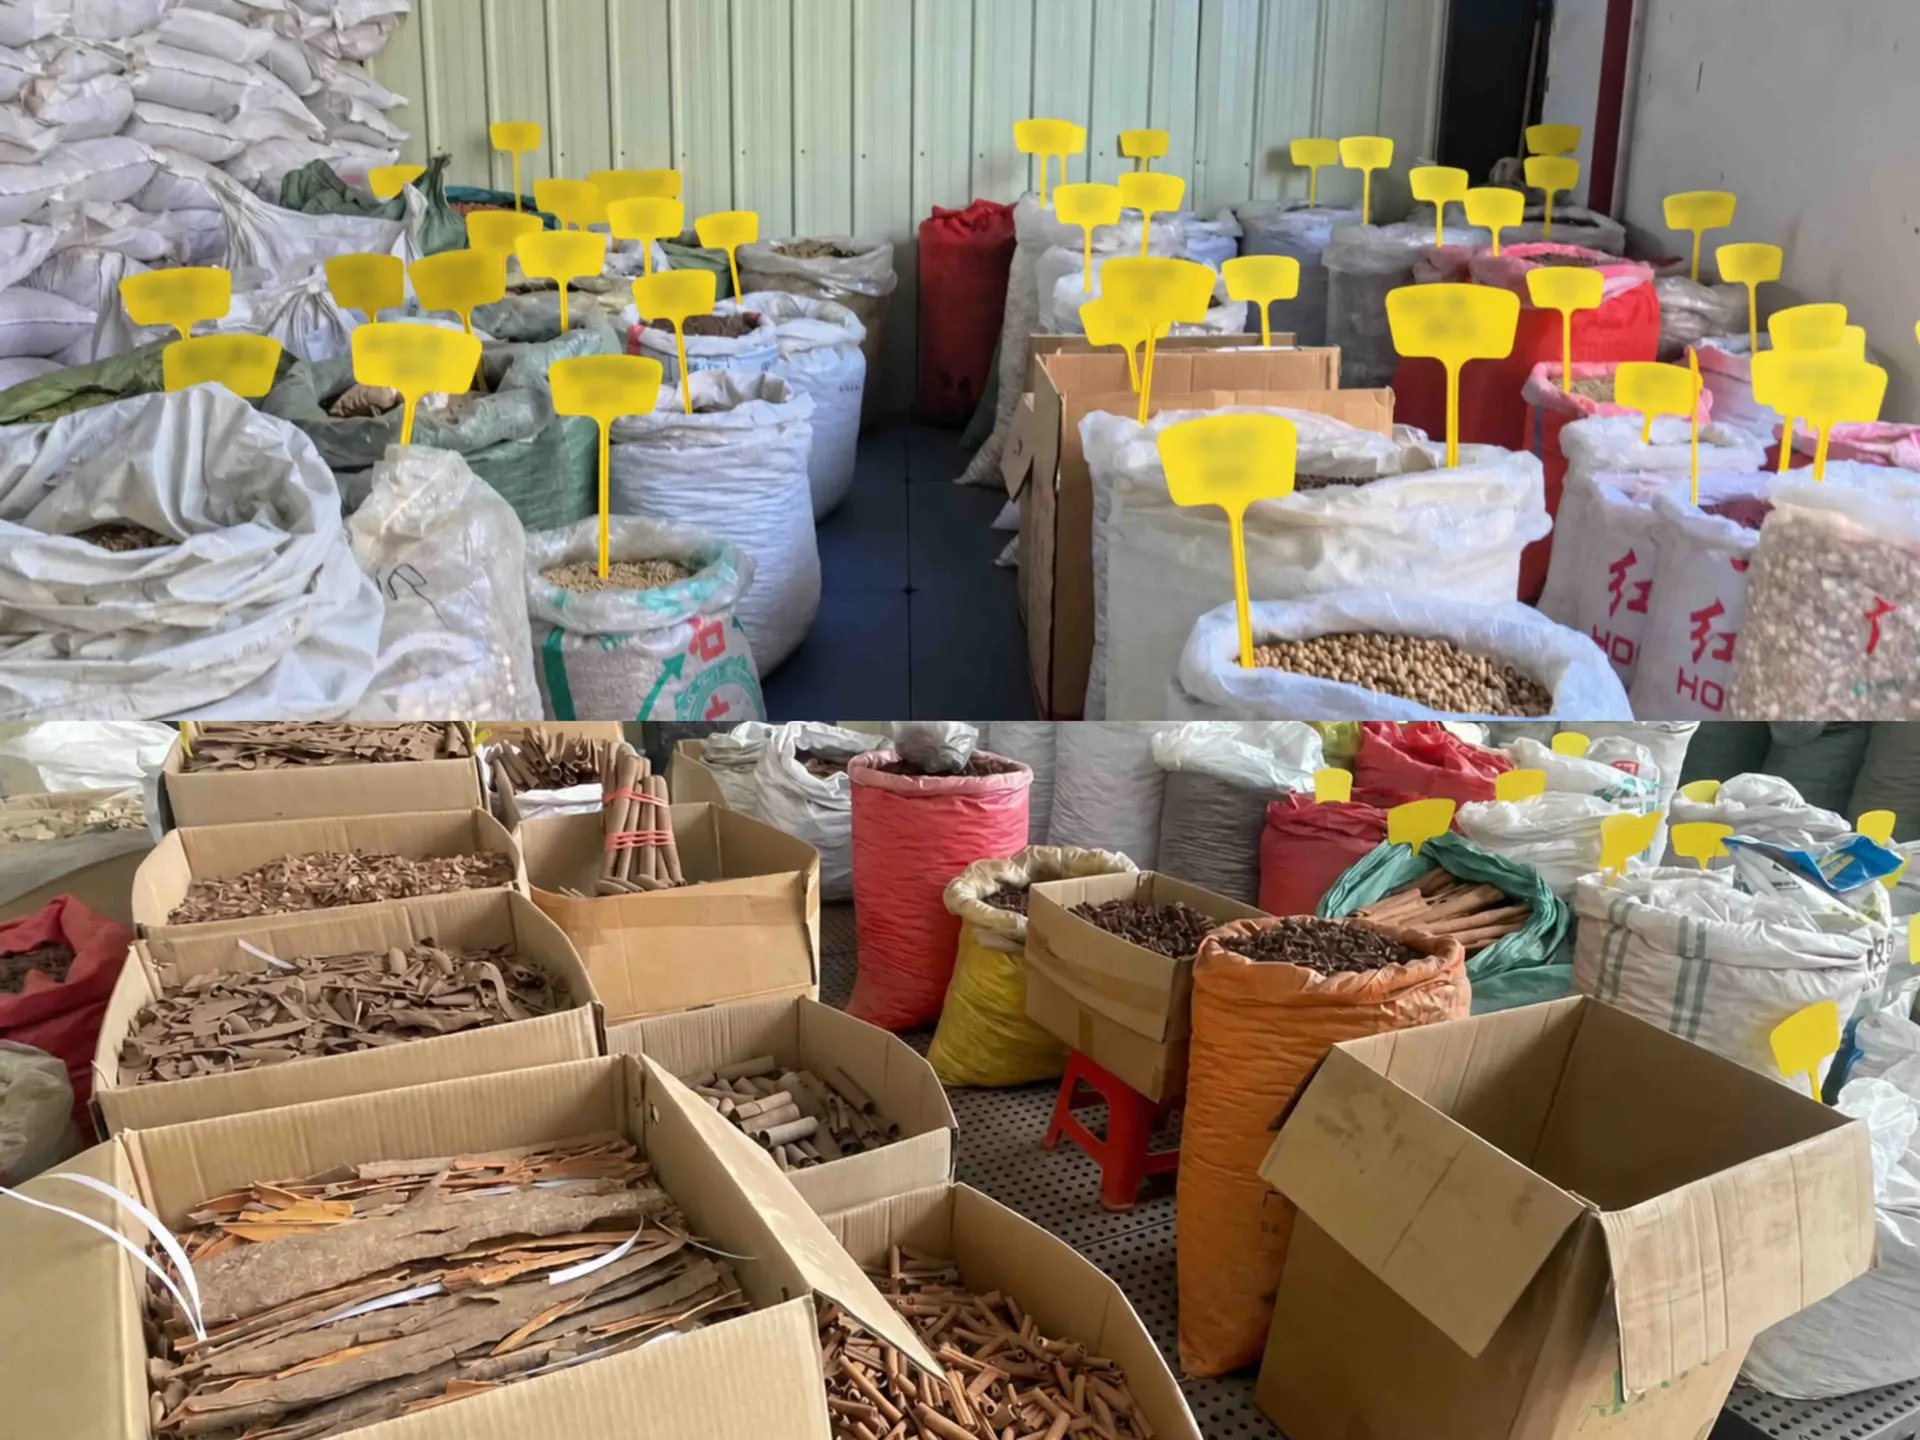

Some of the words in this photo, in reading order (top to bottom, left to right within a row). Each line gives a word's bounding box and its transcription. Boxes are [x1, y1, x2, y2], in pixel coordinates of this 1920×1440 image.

[1608, 549, 1652, 618] 红
[1690, 598, 1737, 664] 红
[1676, 666, 1725, 712] HO
